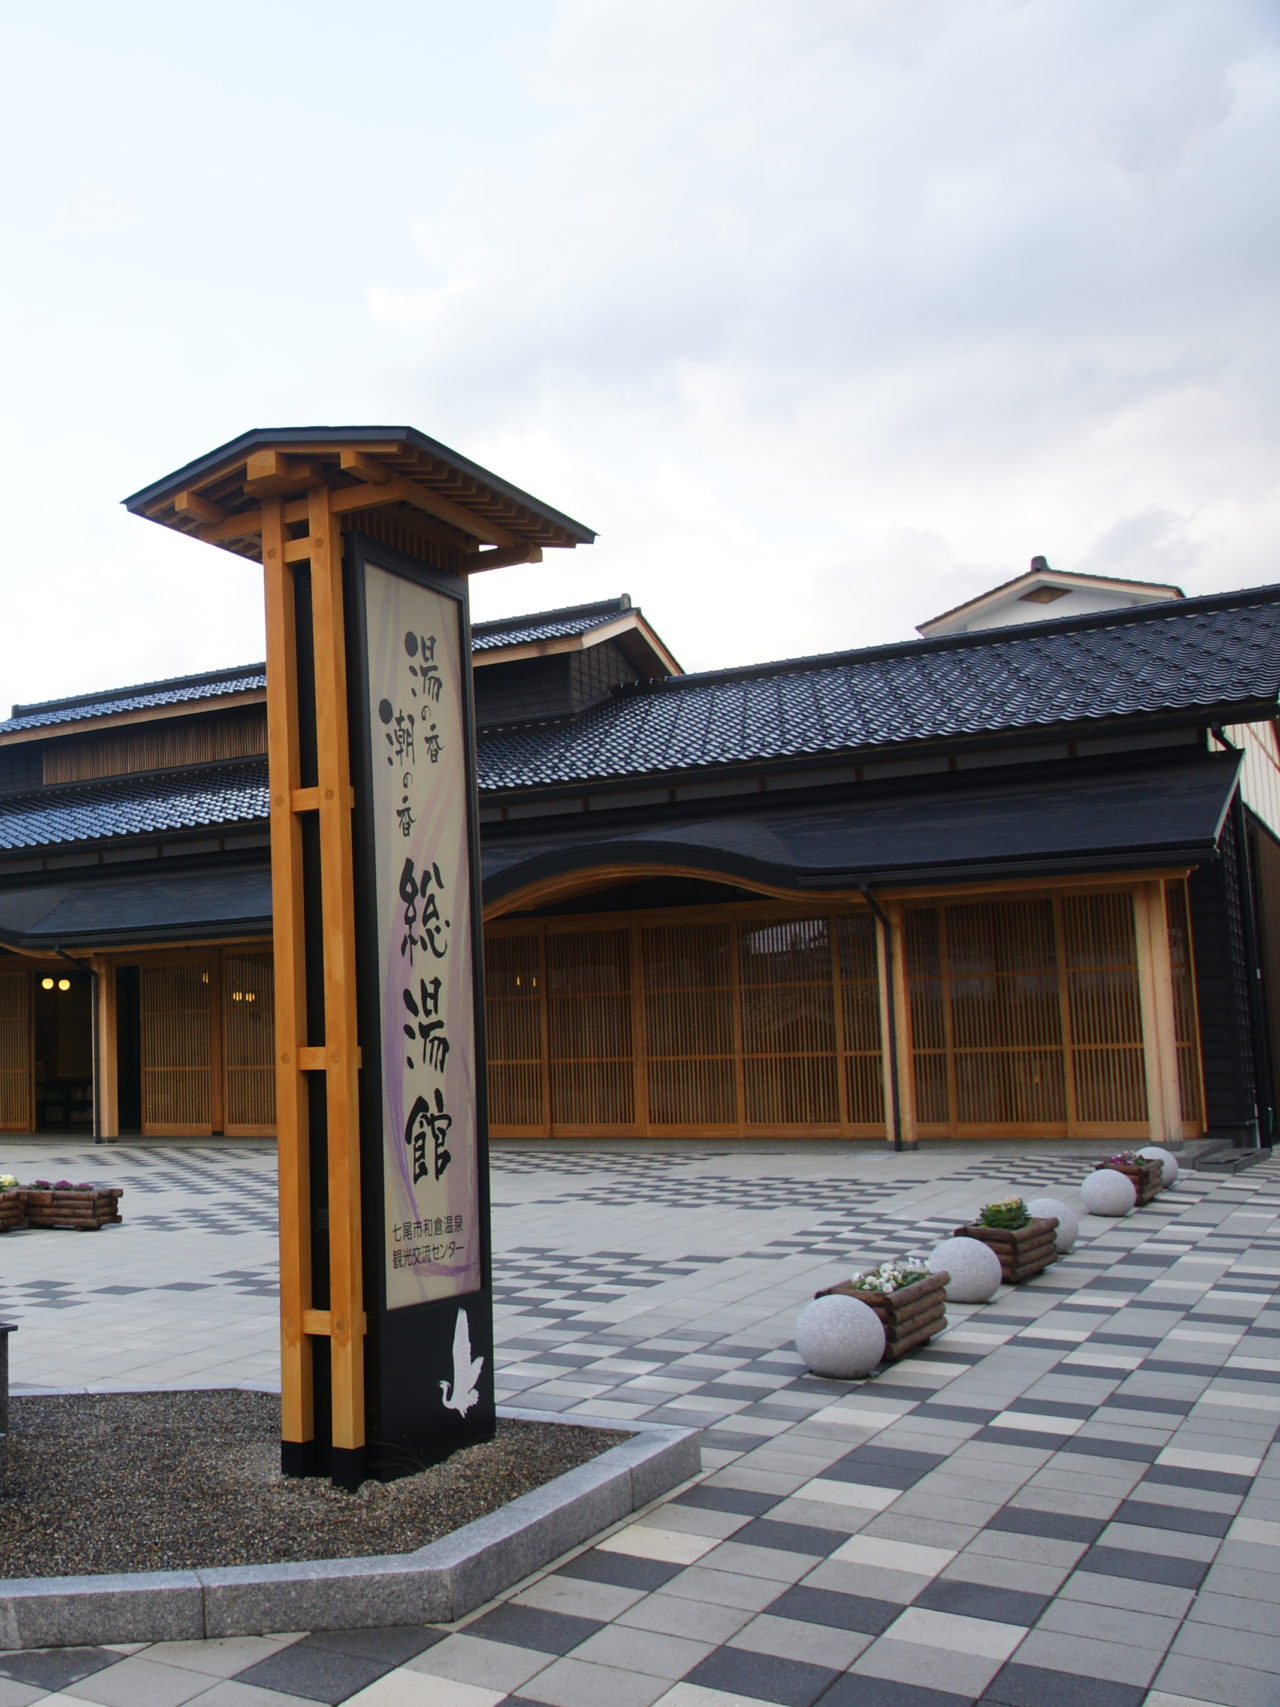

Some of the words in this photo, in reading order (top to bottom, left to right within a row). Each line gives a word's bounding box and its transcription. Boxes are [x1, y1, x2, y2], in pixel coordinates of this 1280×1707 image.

[392, 1214, 464, 1242] 七尾市和倉温泉
[393, 1241, 464, 1269] 観光交流センター
